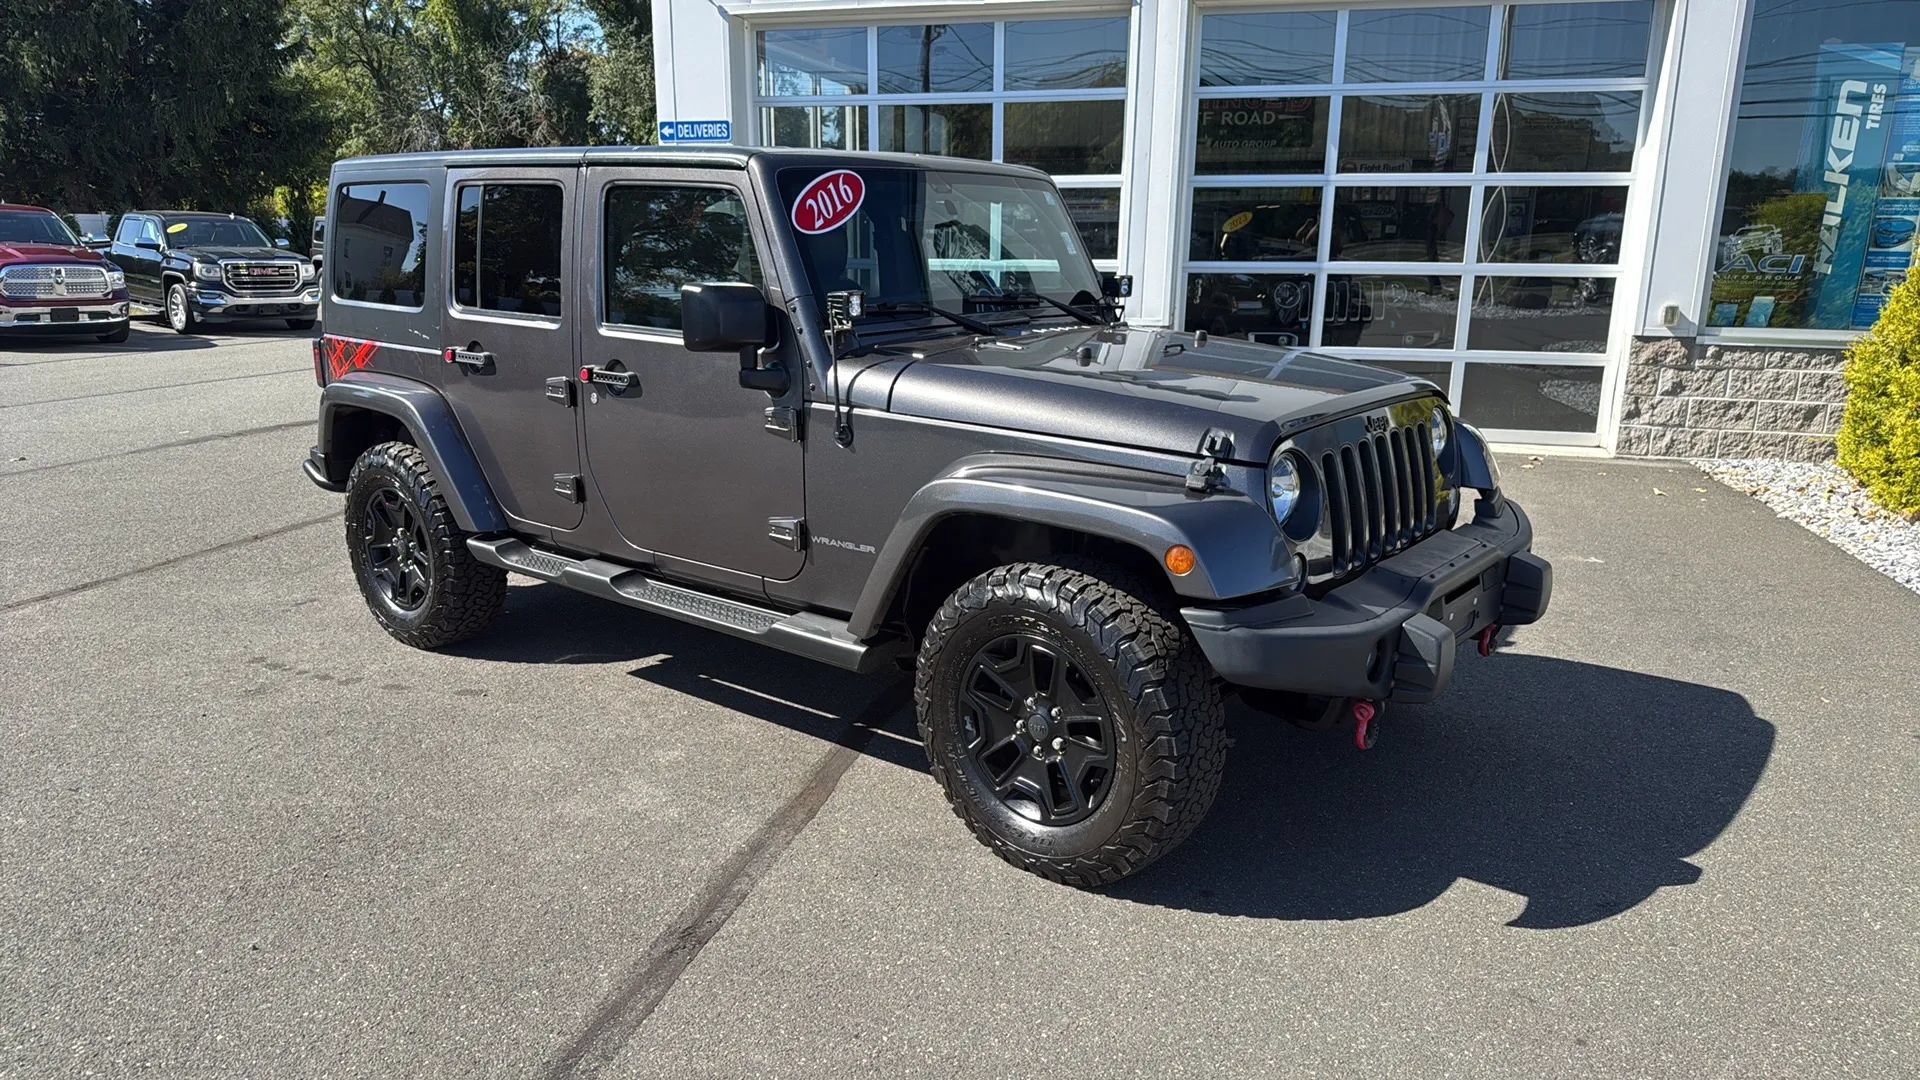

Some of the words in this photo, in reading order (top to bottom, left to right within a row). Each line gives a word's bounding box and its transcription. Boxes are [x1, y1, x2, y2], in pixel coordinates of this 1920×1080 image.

[1865, 83, 1888, 129] TIRES
[1221, 111, 1276, 125] ROAD
[677, 122, 728, 139] DELIVERIES
[1212, 139, 1239, 149] AUTO
[1241, 139, 1278, 149] GROUP
[806, 174, 854, 230] 2016
[249, 267, 279, 276] GMC
[1718, 254, 1806, 274] ACI
[1755, 273, 1802, 281] GROUP
[1365, 415, 1390, 433] Jeep
[811, 535, 876, 554] WRANGLER
